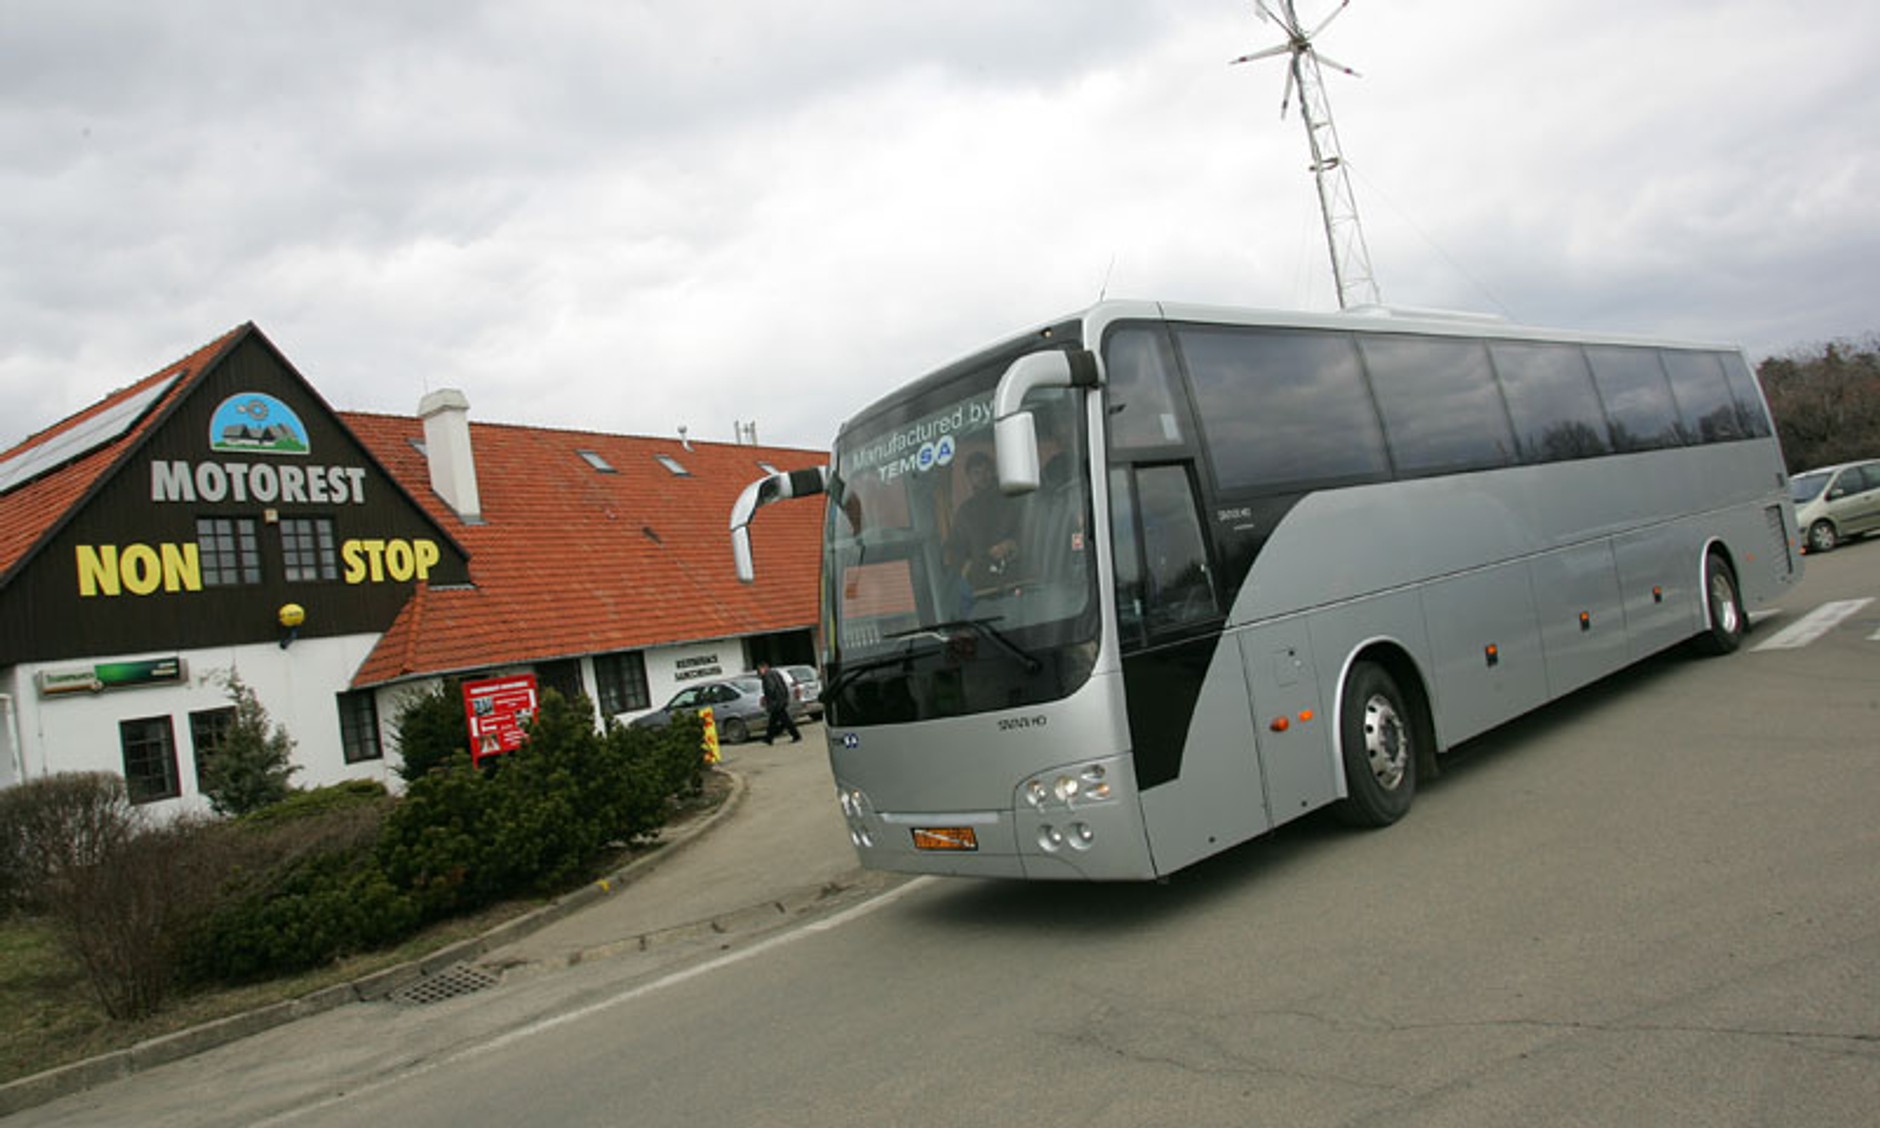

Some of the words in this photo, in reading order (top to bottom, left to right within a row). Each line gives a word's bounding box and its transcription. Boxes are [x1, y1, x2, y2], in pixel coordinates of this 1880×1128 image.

[852, 406, 963, 472] Manufactured
[970, 399, 994, 425] by
[880, 434, 956, 481] TEMSA
[151, 460, 366, 504] MOTOREST
[75, 542, 203, 596] NON
[341, 539, 440, 584] STOP
